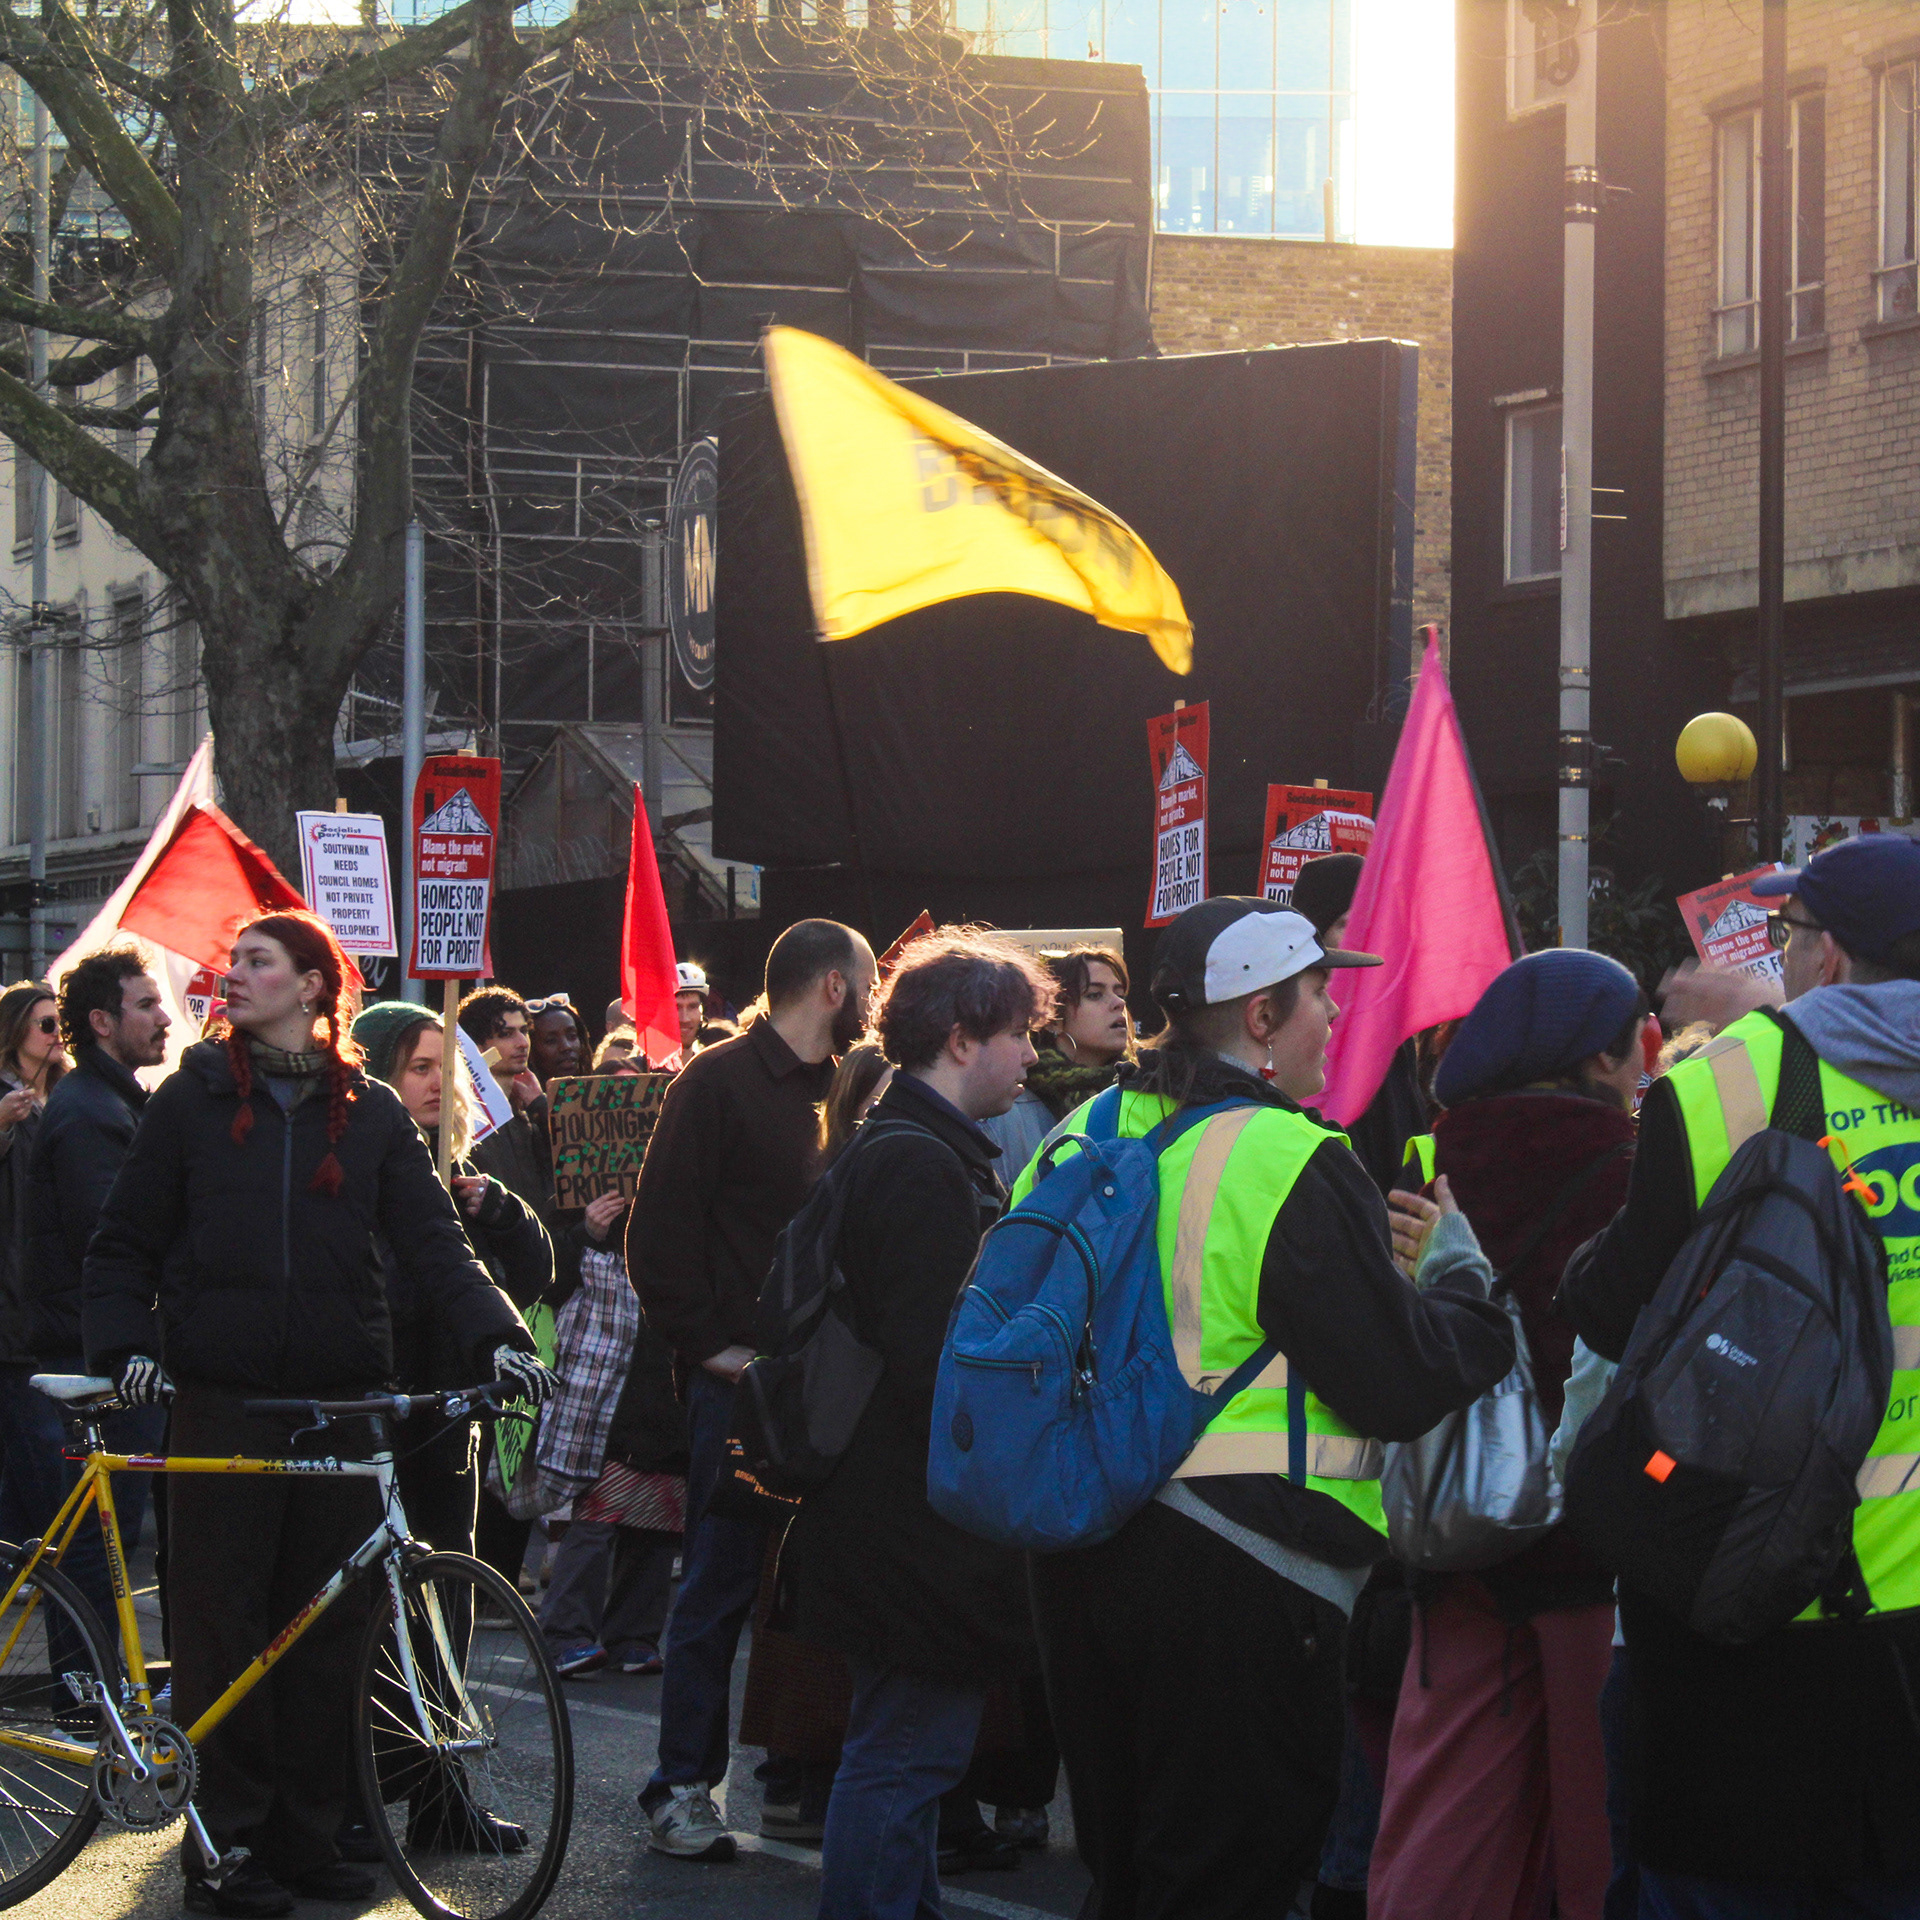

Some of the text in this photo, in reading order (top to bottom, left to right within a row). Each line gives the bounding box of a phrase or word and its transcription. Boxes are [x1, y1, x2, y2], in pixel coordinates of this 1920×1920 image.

[320, 823, 361, 834] Socialist
[322, 843, 370, 856] SOUTHWARK
[422, 838, 446, 856] Blame
[448, 839, 462, 856] the
[1184, 826, 1200, 854] FOR
[333, 859, 359, 872] NEEDS
[421, 857, 469, 876] not migrants
[1185, 851, 1202, 878] NOT
[1271, 851, 1298, 866] Blame
[318, 874, 379, 889] COUNCIL HOMES
[1269, 867, 1284, 879] not
[325, 891, 375, 905] NOT PRIVATE
[420, 884, 484, 911] HOMES FOR
[1172, 878, 1200, 909] PROFIT
[331, 907, 371, 920] PROPERTY
[329, 924, 380, 937] EVELOPMENT
[420, 911, 484, 938] PEOPLE NOT
[420, 938, 481, 965] FOR PROFIT
[1708, 940, 1735, 957] Blame
[1735, 934, 1751, 948] the
[1729, 942, 1766, 960] migrants
[1730, 959, 1769, 981] OMES
[187, 996, 205, 1014] OR
[550, 1109, 639, 1146] HOUSING
[1824, 1108, 1866, 1131] OP
[1887, 1246, 1909, 1265] nd
[103, 1528, 126, 1599] SHIMANO
